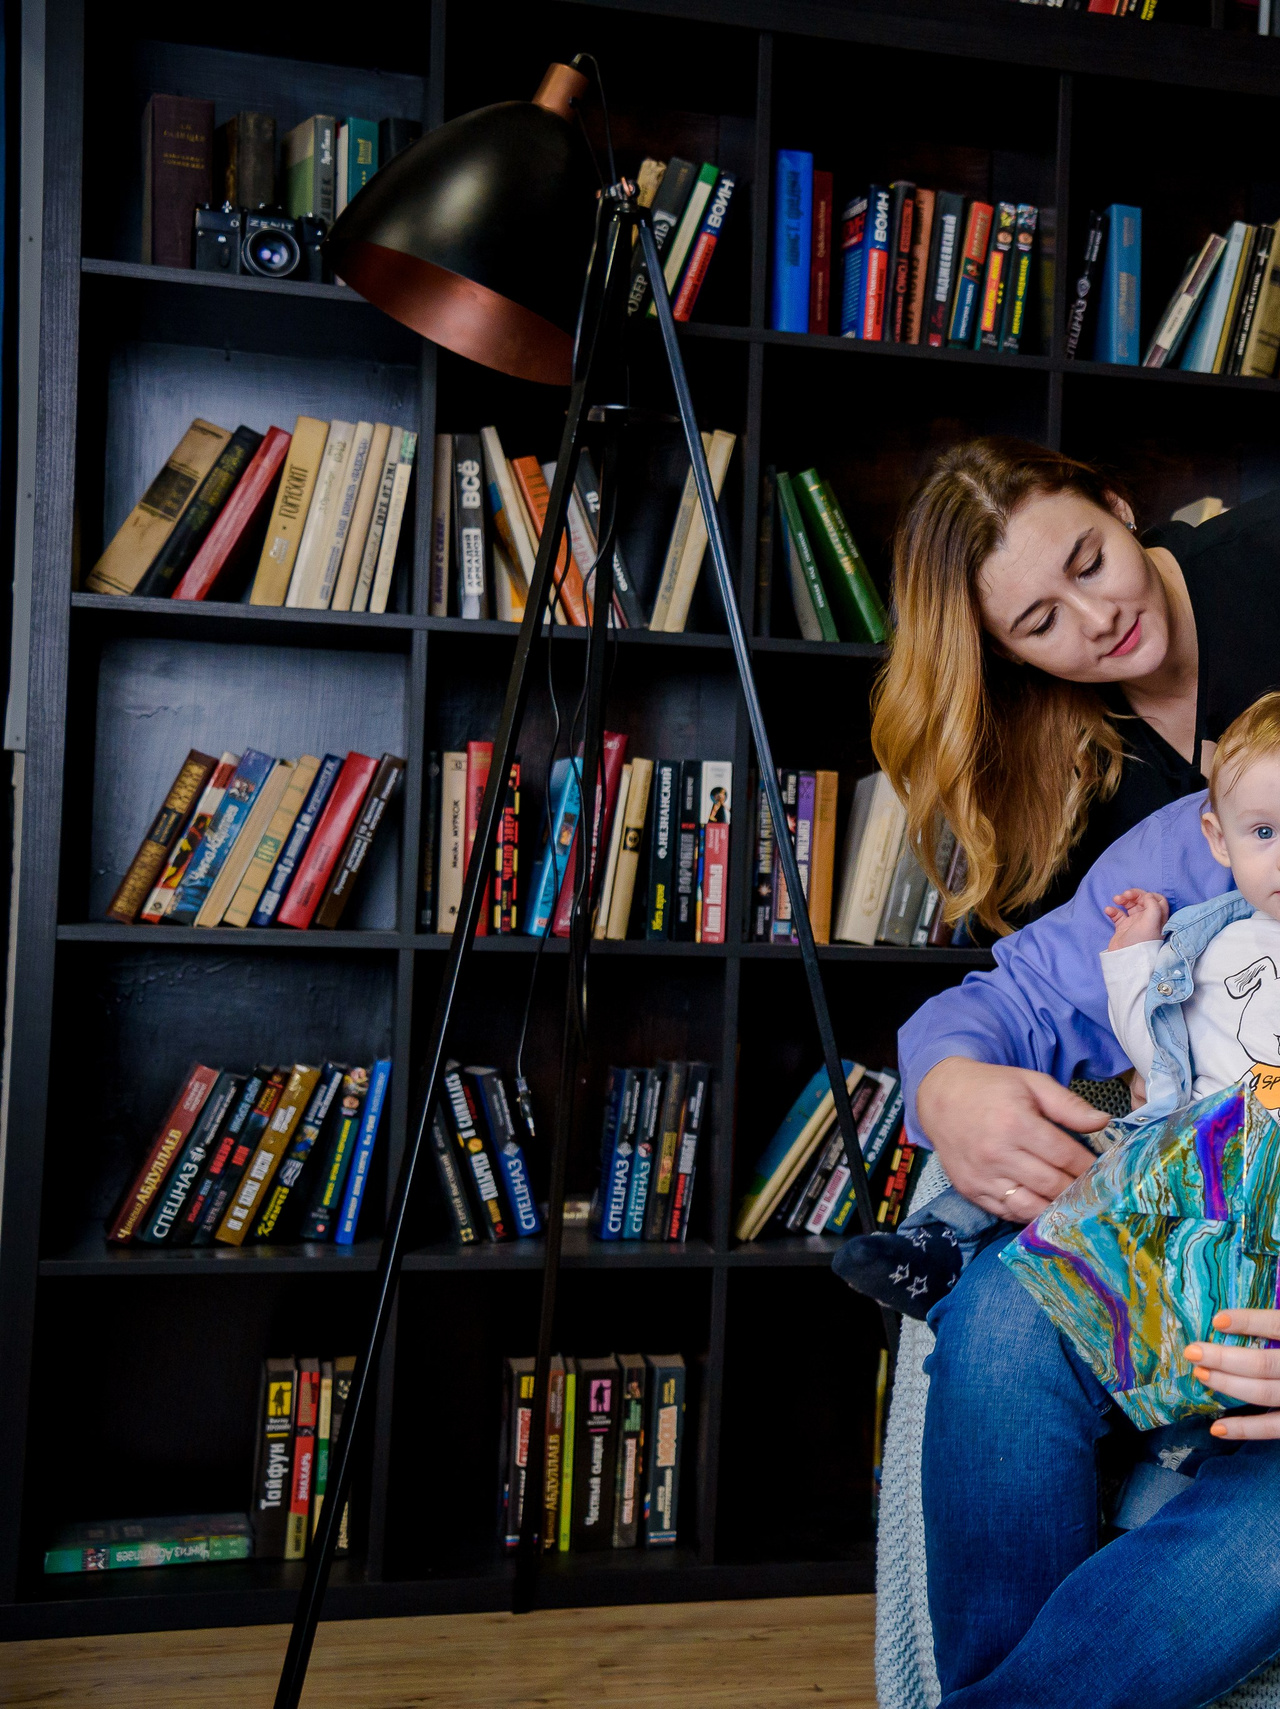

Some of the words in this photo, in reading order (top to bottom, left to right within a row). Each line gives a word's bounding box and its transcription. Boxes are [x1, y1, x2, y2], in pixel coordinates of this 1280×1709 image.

[249, 218, 294, 230] ZENIT
[705, 177, 735, 228] ВОИН
[874, 192, 889, 242] ВОИН
[277, 463, 309, 520] ГОРИЗОНТ
[381, 485, 391, 498] ОТ
[385, 461, 396, 480] УМА
[375, 501, 387, 526] ГОРЕ
[464, 534, 473, 587] АРКАДИЙ
[473, 534, 482, 588] АРКАНОВ
[503, 805, 515, 843] ЗВЕРЯ
[502, 843, 514, 881] ЧИСЛО
[865, 1095, 904, 1163] Ф.НЕЗНАНСК
[135, 1126, 183, 1205] АБДУЛЛАЕВ
[150, 1160, 199, 1240] СПЕЦНАЗ
[452, 1196, 468, 1225] СЕРГЕЙ
[507, 1157, 536, 1230] СПЕЦНАЗ
[607, 1159, 629, 1233] СПЕЦНАЗ
[631, 1160, 651, 1233] СПЕЦНАЗ
[261, 1443, 289, 1510] Тайфун
[298, 1453, 311, 1501] ЗНАХАРЬ
[544, 1433, 559, 1510] АБДУЛЛАЕВ
[115, 1547, 174, 1562] Абдуллаев
[173, 1544, 210, 1561] Чингиз
